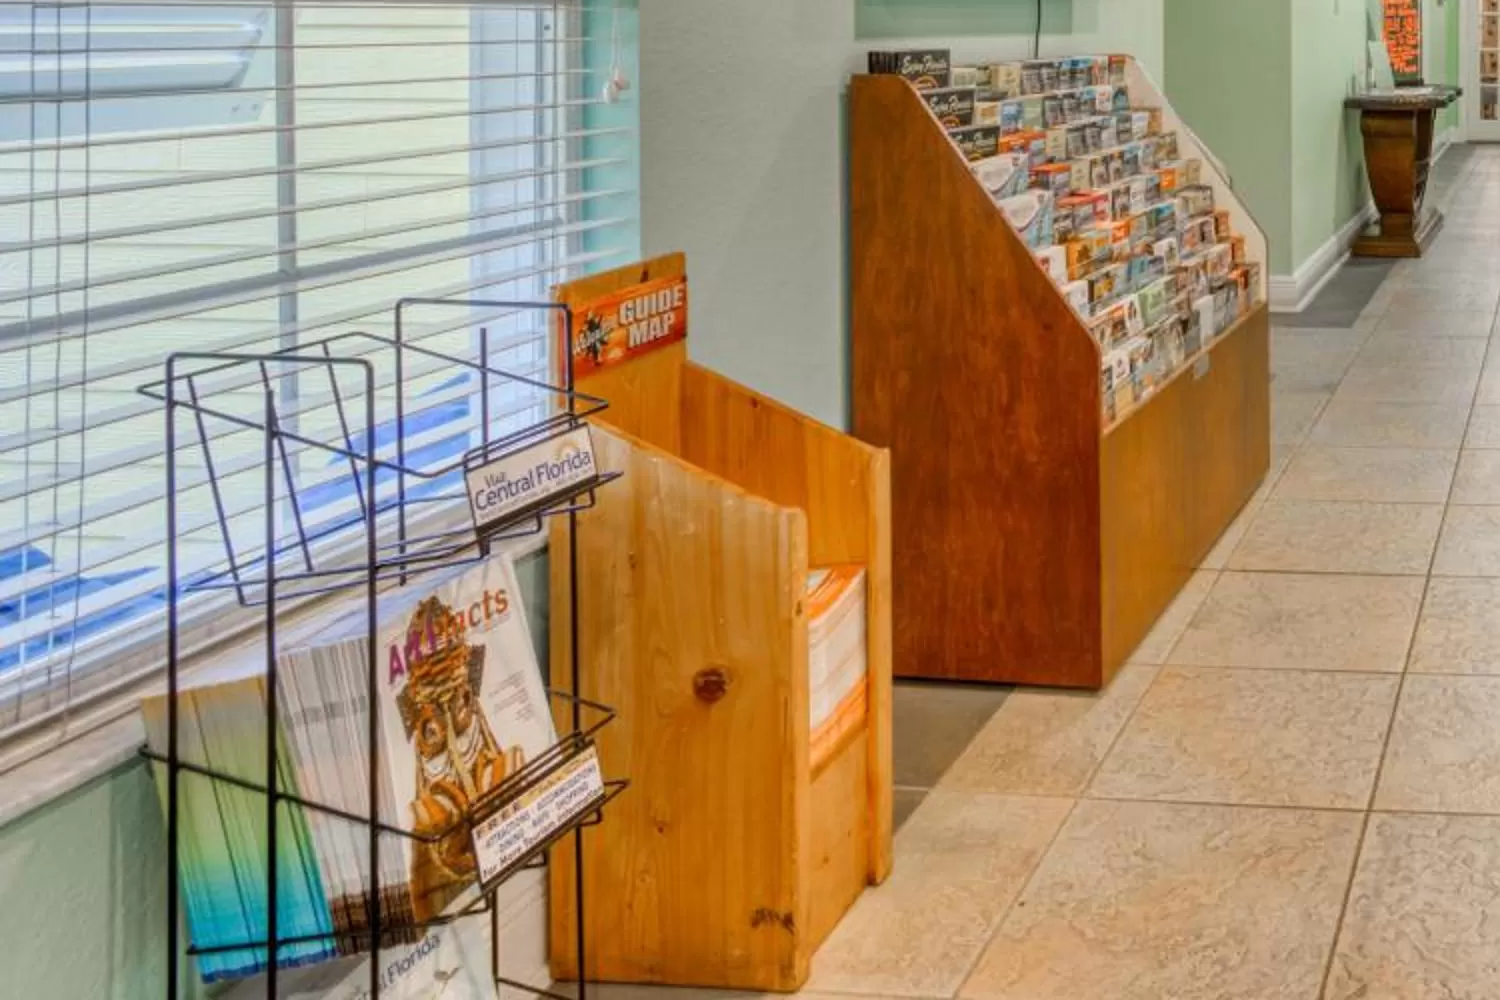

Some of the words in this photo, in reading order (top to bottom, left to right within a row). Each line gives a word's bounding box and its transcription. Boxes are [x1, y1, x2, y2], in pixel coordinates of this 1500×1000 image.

[619, 283, 684, 326] GUIDE
[629, 312, 676, 348] MAP
[475, 472, 535, 511] Central
[535, 449, 592, 485] Florida
[386, 934, 442, 985] Florida
